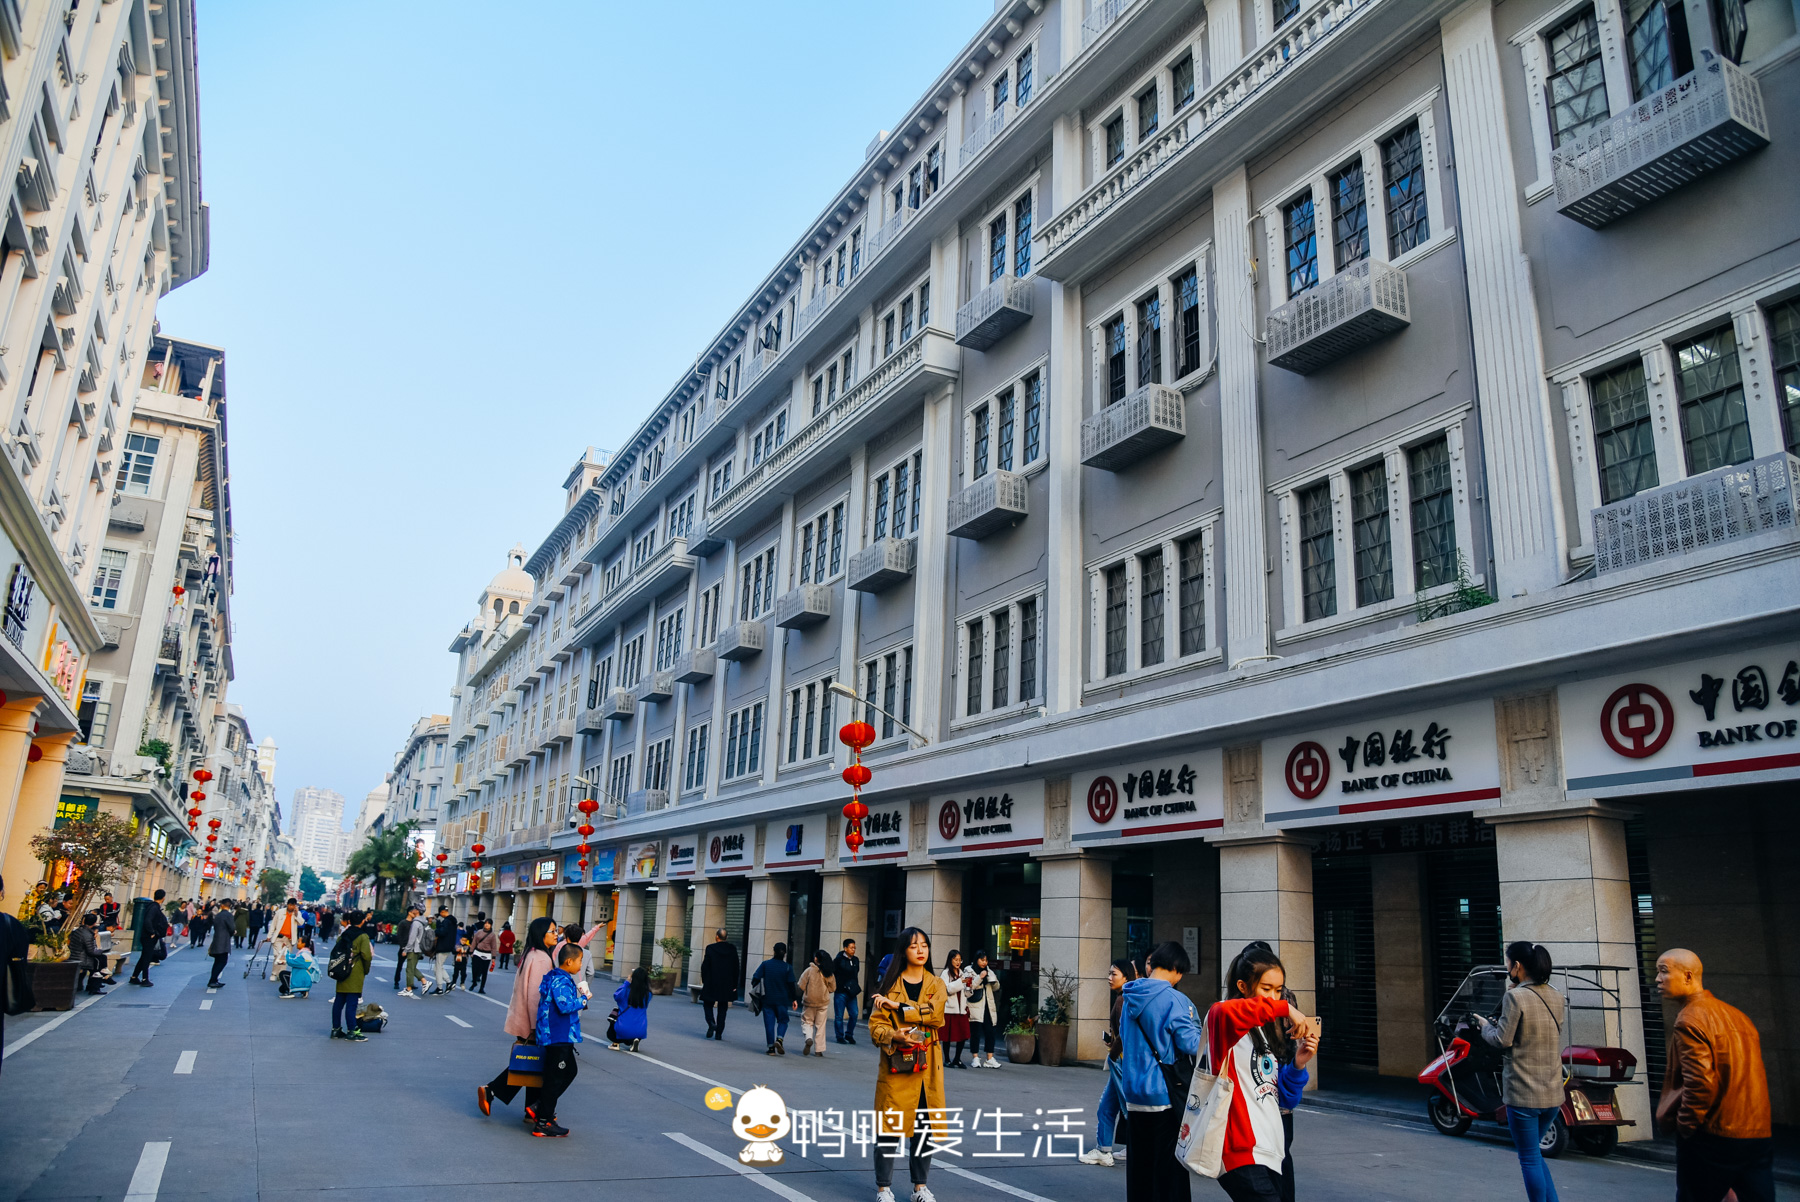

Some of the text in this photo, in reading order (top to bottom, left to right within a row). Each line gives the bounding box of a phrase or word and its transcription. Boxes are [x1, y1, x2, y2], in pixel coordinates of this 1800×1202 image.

[1697, 719, 1798, 748] BANK OF
[1341, 767, 1453, 793] BANK OF CHINA
[1123, 800, 1197, 819] BANK OF CHINA
